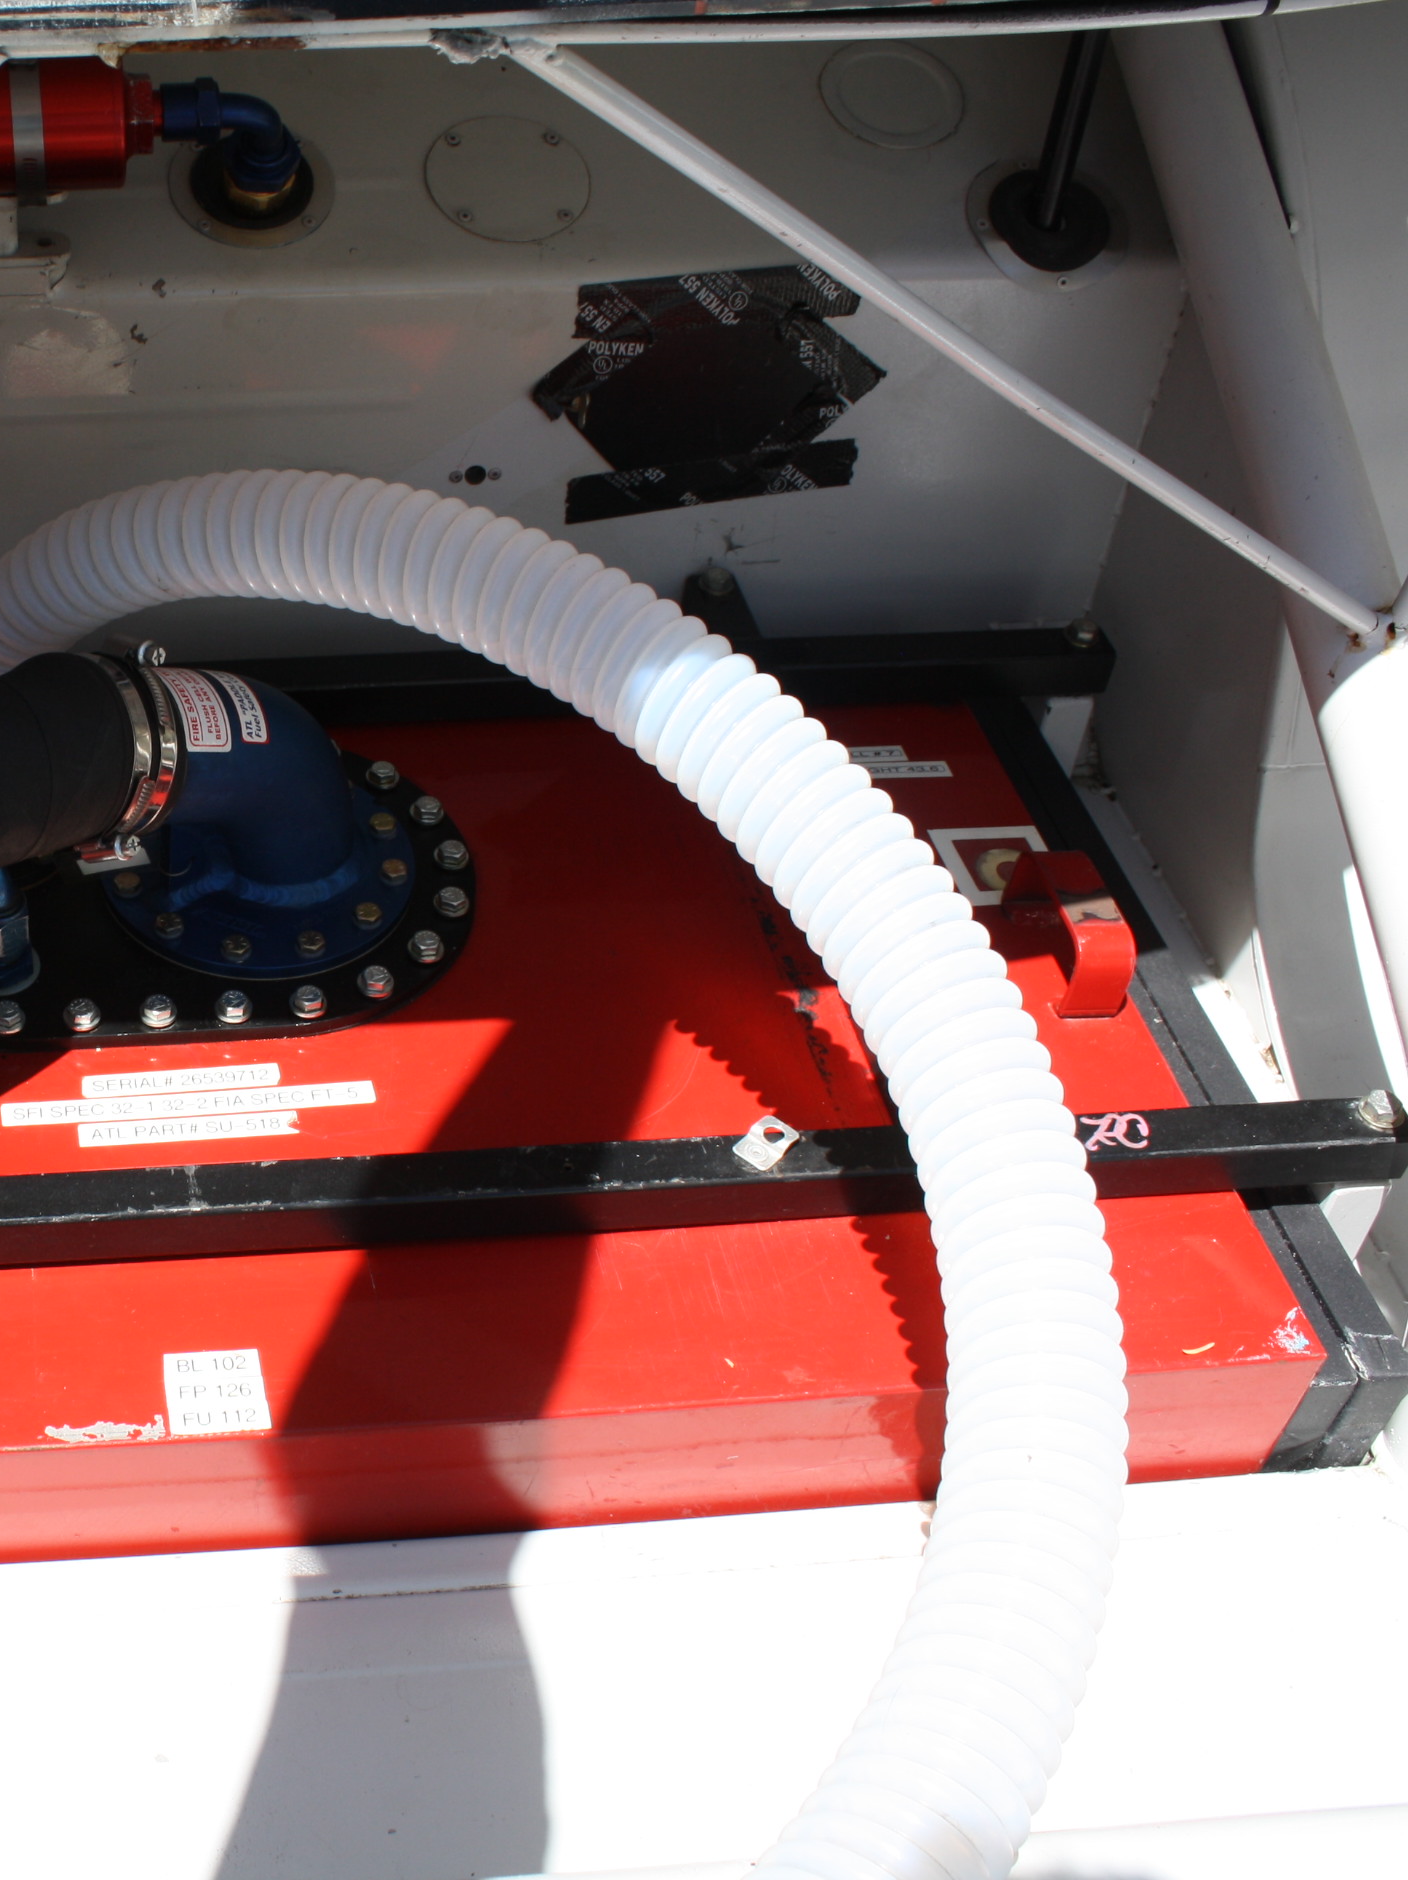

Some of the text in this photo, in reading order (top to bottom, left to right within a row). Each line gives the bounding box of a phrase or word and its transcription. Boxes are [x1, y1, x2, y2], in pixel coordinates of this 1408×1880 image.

[678, 274, 701, 293] 557
[587, 341, 645, 356] POLYKEN
[192, 716, 201, 742] FIRE
[202, 704, 214, 734] FLUSH
[209, 705, 222, 740] BEFORE
[245, 720, 254, 740] ATL
[252, 714, 263, 738] Fuel
[92, 1069, 269, 1093] SERIAL# 26539712
[13, 1086, 359, 1121] SFI SPEC 32-1 32-2 FIA SPEC FT-5
[92, 1117, 281, 1140] ATL PART# SU-518
[177, 1355, 248, 1373] BL 102
[179, 1382, 252, 1399] FP 126
[183, 1408, 257, 1427] FU 112
